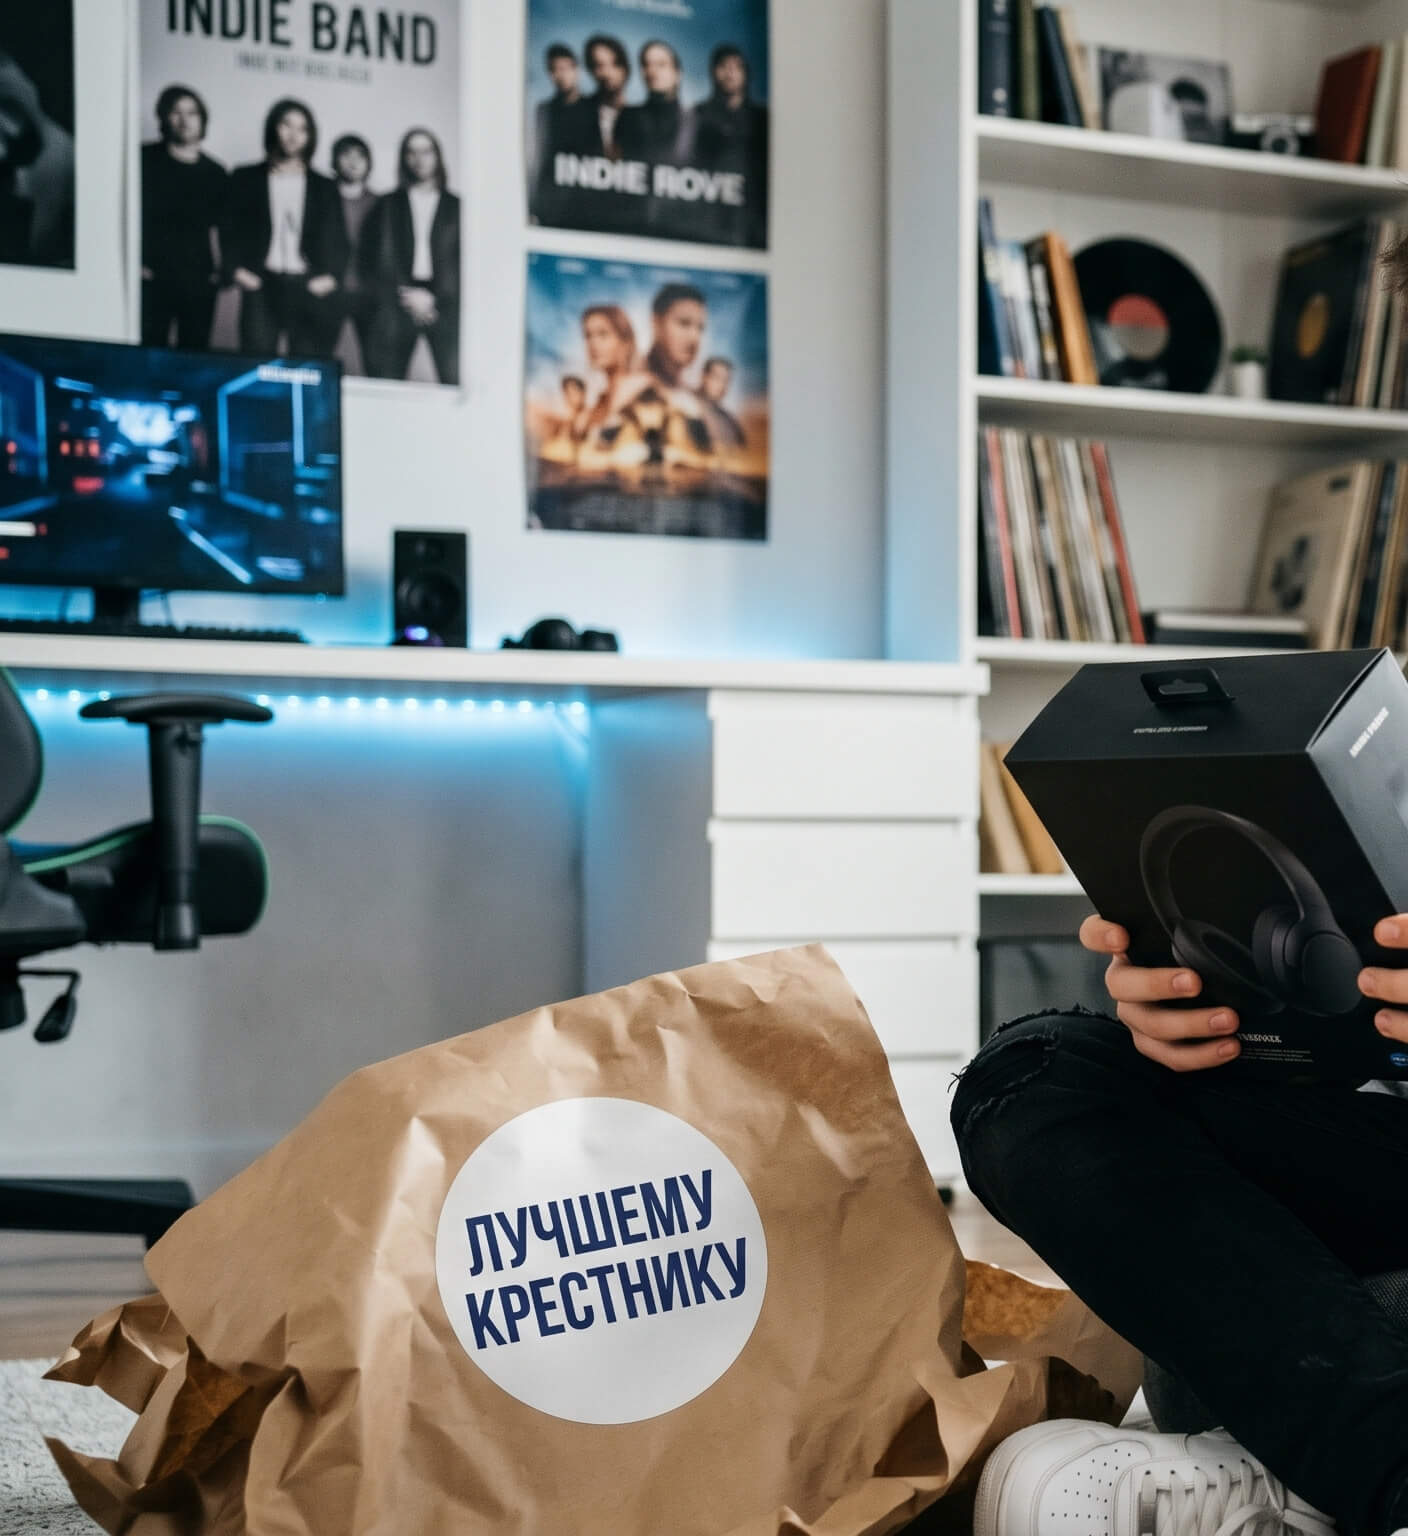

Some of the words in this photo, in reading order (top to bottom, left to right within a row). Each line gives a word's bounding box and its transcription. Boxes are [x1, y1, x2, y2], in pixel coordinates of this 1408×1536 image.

[167, 0, 292, 47] INDIE
[311, 2, 436, 65] BAND
[554, 153, 649, 195] INDIE
[465, 1169, 712, 1277] ЛУЧШЕМУ
[465, 1237, 747, 1350] КРЕСТНИКУ
